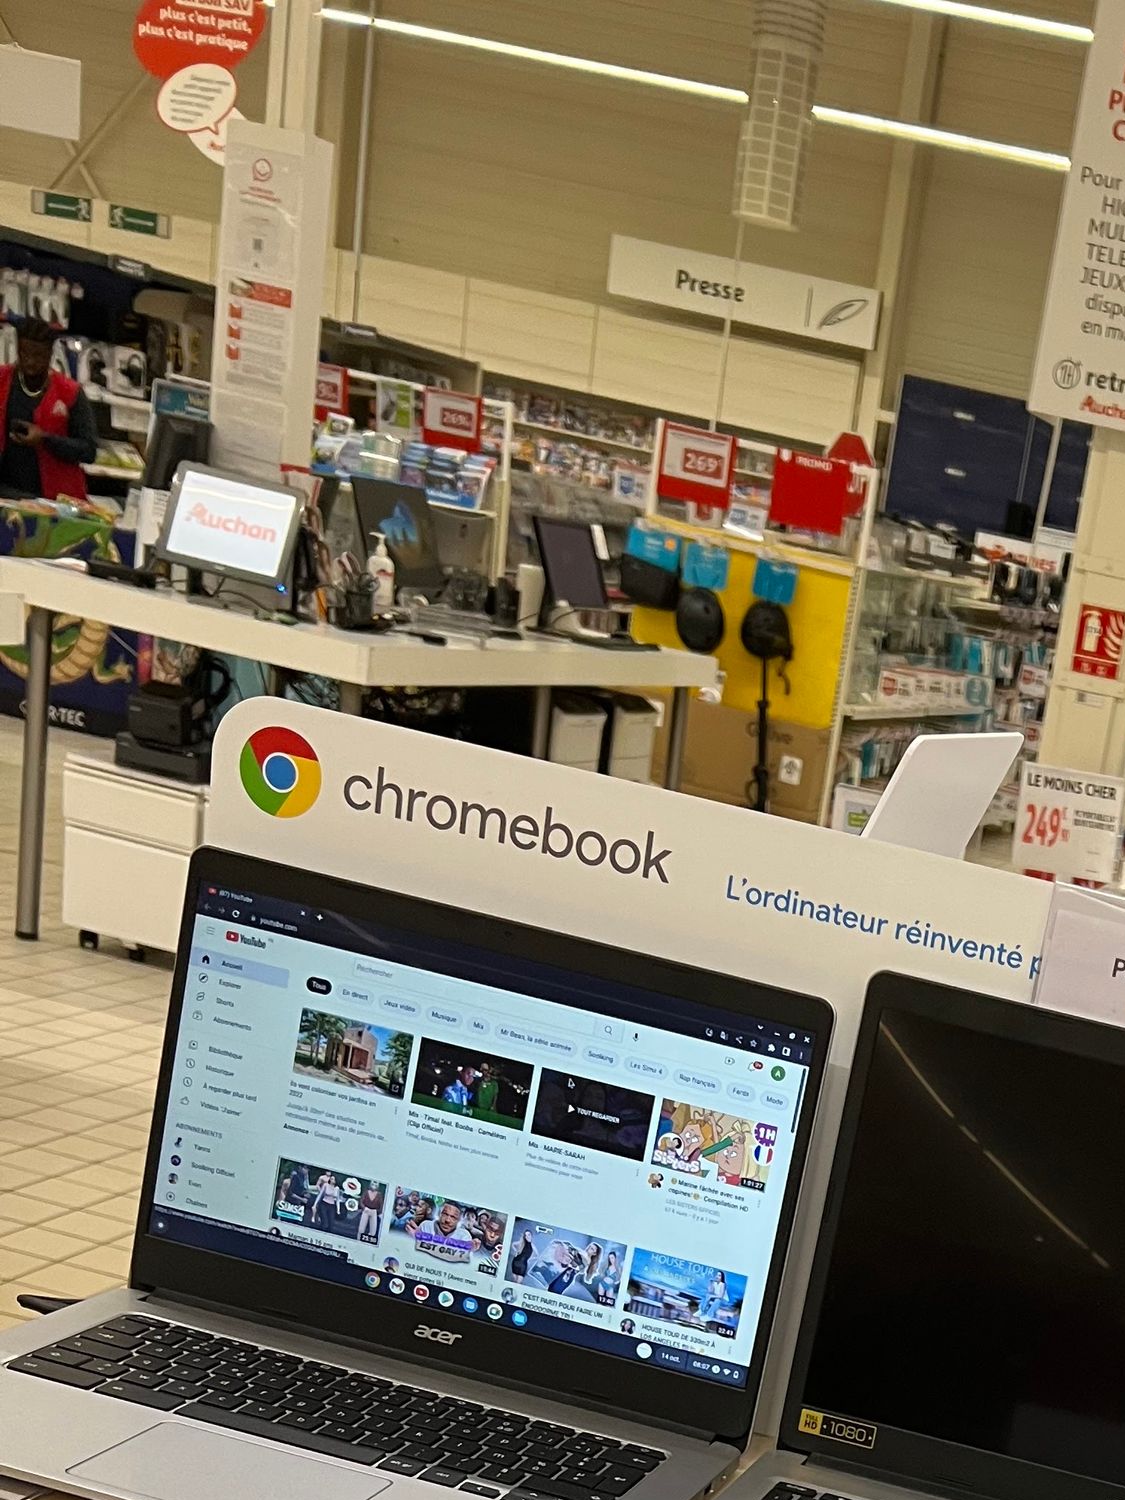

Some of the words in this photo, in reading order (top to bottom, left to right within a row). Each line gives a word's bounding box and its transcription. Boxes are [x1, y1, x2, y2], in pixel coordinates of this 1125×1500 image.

[159, 6, 186, 20] plus
[188, 12, 216, 26] c'est
[217, 18, 252, 34] petit,
[138, 22, 165, 36] plus
[166, 27, 194, 41] c'est
[196, 33, 248, 52] pratique
[1080, 166, 1122, 191] Pour
[676, 269, 746, 302] Presse
[1080, 320, 1103, 336] en
[184, 502, 277, 544] Auchan
[1026, 772, 1040, 788] LE
[1086, 782, 1118, 801] CHER
[343, 766, 673, 885] chromebook
[1022, 803, 1062, 848] 249
[259, 917, 298, 932] youtube.com
[725, 874, 889, 938] L'ordinateur
[894, 920, 1023, 969] réinventé
[240, 930, 267, 950] YouTube
[431, 1010, 458, 1023] Musique
[577, 1107, 592, 1117] TOUT
[413, 1323, 463, 1347] acer
[804, 1421, 817, 1429] HD
[830, 1421, 866, 1442] 1080
